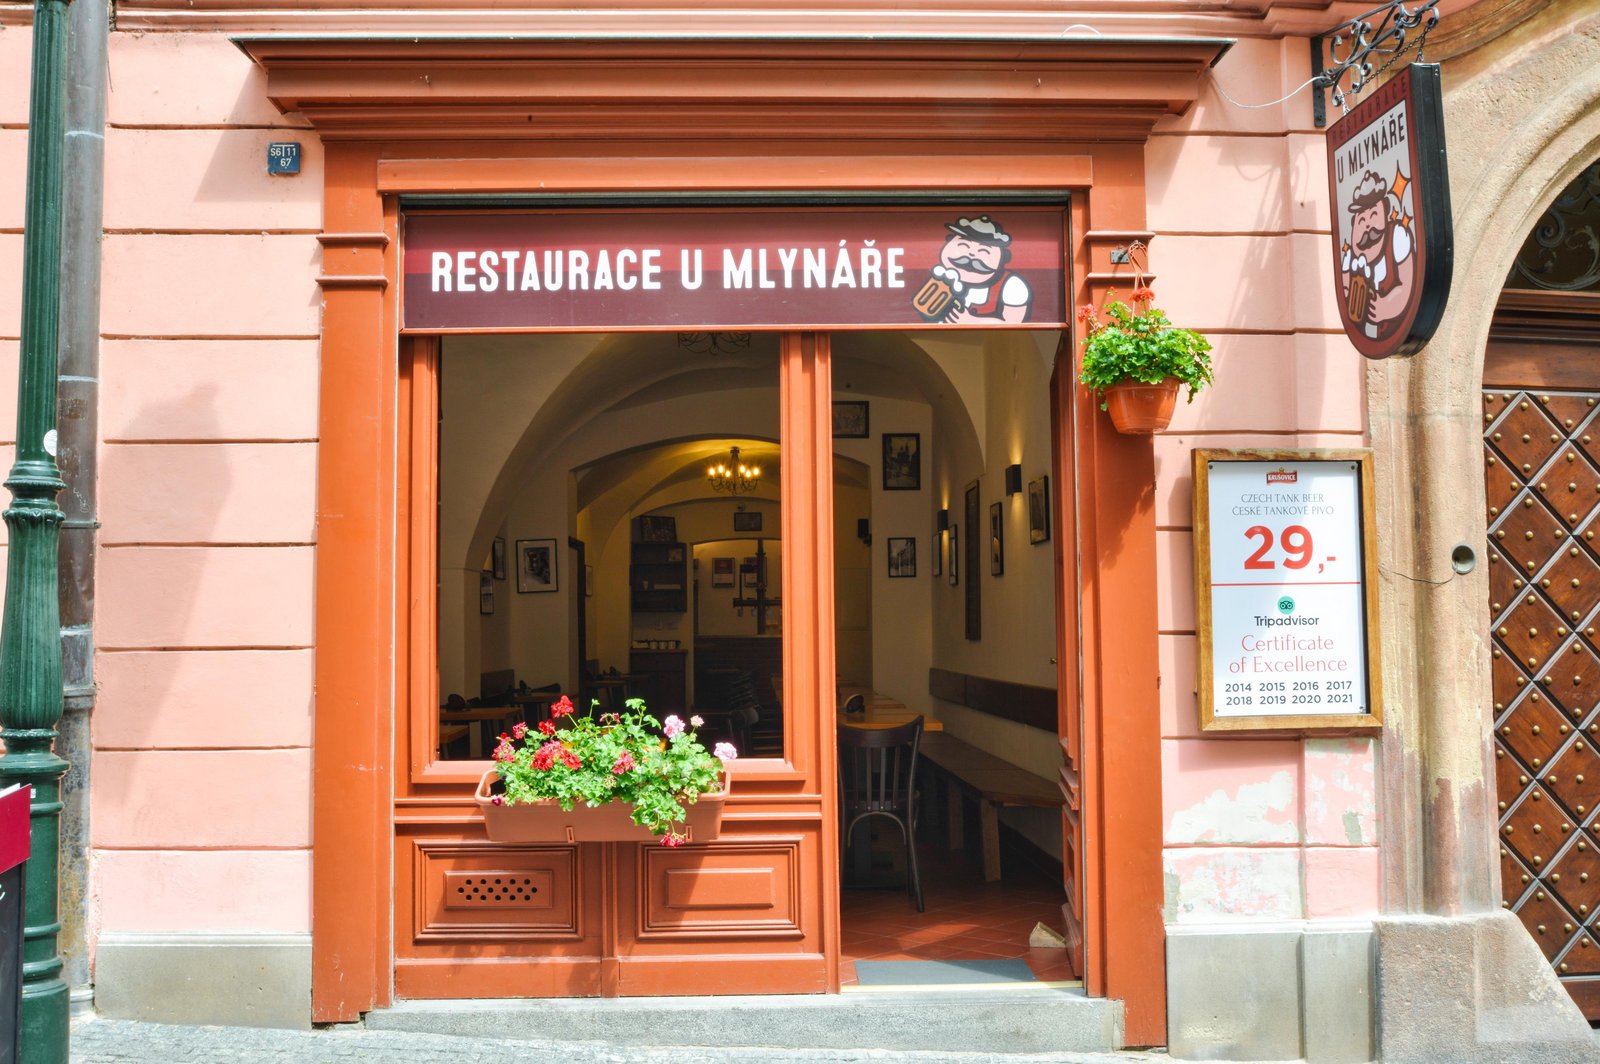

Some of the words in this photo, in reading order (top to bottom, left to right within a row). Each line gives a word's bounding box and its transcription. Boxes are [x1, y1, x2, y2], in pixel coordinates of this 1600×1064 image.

[1332, 75, 1408, 144] RESTAURACE
[1337, 156, 1344, 183] U
[1348, 112, 1405, 176] MLYNÁŘE
[280, 158, 292, 167] 67
[431, 249, 662, 292] RESTAURACE
[681, 249, 703, 290] U
[723, 239, 905, 289] MLYNÁŘE
[1267, 473, 1296, 481] KRUŠOVICE
[1240, 493, 1273, 503] CZECH
[1275, 493, 1299, 503] TANK
[1302, 493, 1325, 503] BEER
[1232, 503, 1262, 516] ČESKÉ
[1265, 504, 1309, 515] TANKOVÉ
[1311, 505, 1334, 515] PIVO
[1243, 524, 1337, 574] 29,-
[1254, 615, 1320, 628] Tripadvisor
[1241, 634, 1334, 652] Certificate
[1229, 656, 1247, 673] of
[1253, 655, 1348, 673] Excellence
[1225, 682, 1252, 693] 2014
[1259, 682, 1286, 692] 2015
[1292, 681, 1319, 691] 2016
[1326, 680, 1353, 690] 2017
[1226, 696, 1253, 706] 2018
[1259, 695, 1286, 705] 2019
[1291, 694, 1321, 704] 2020
[1326, 693, 1353, 703] 2021
